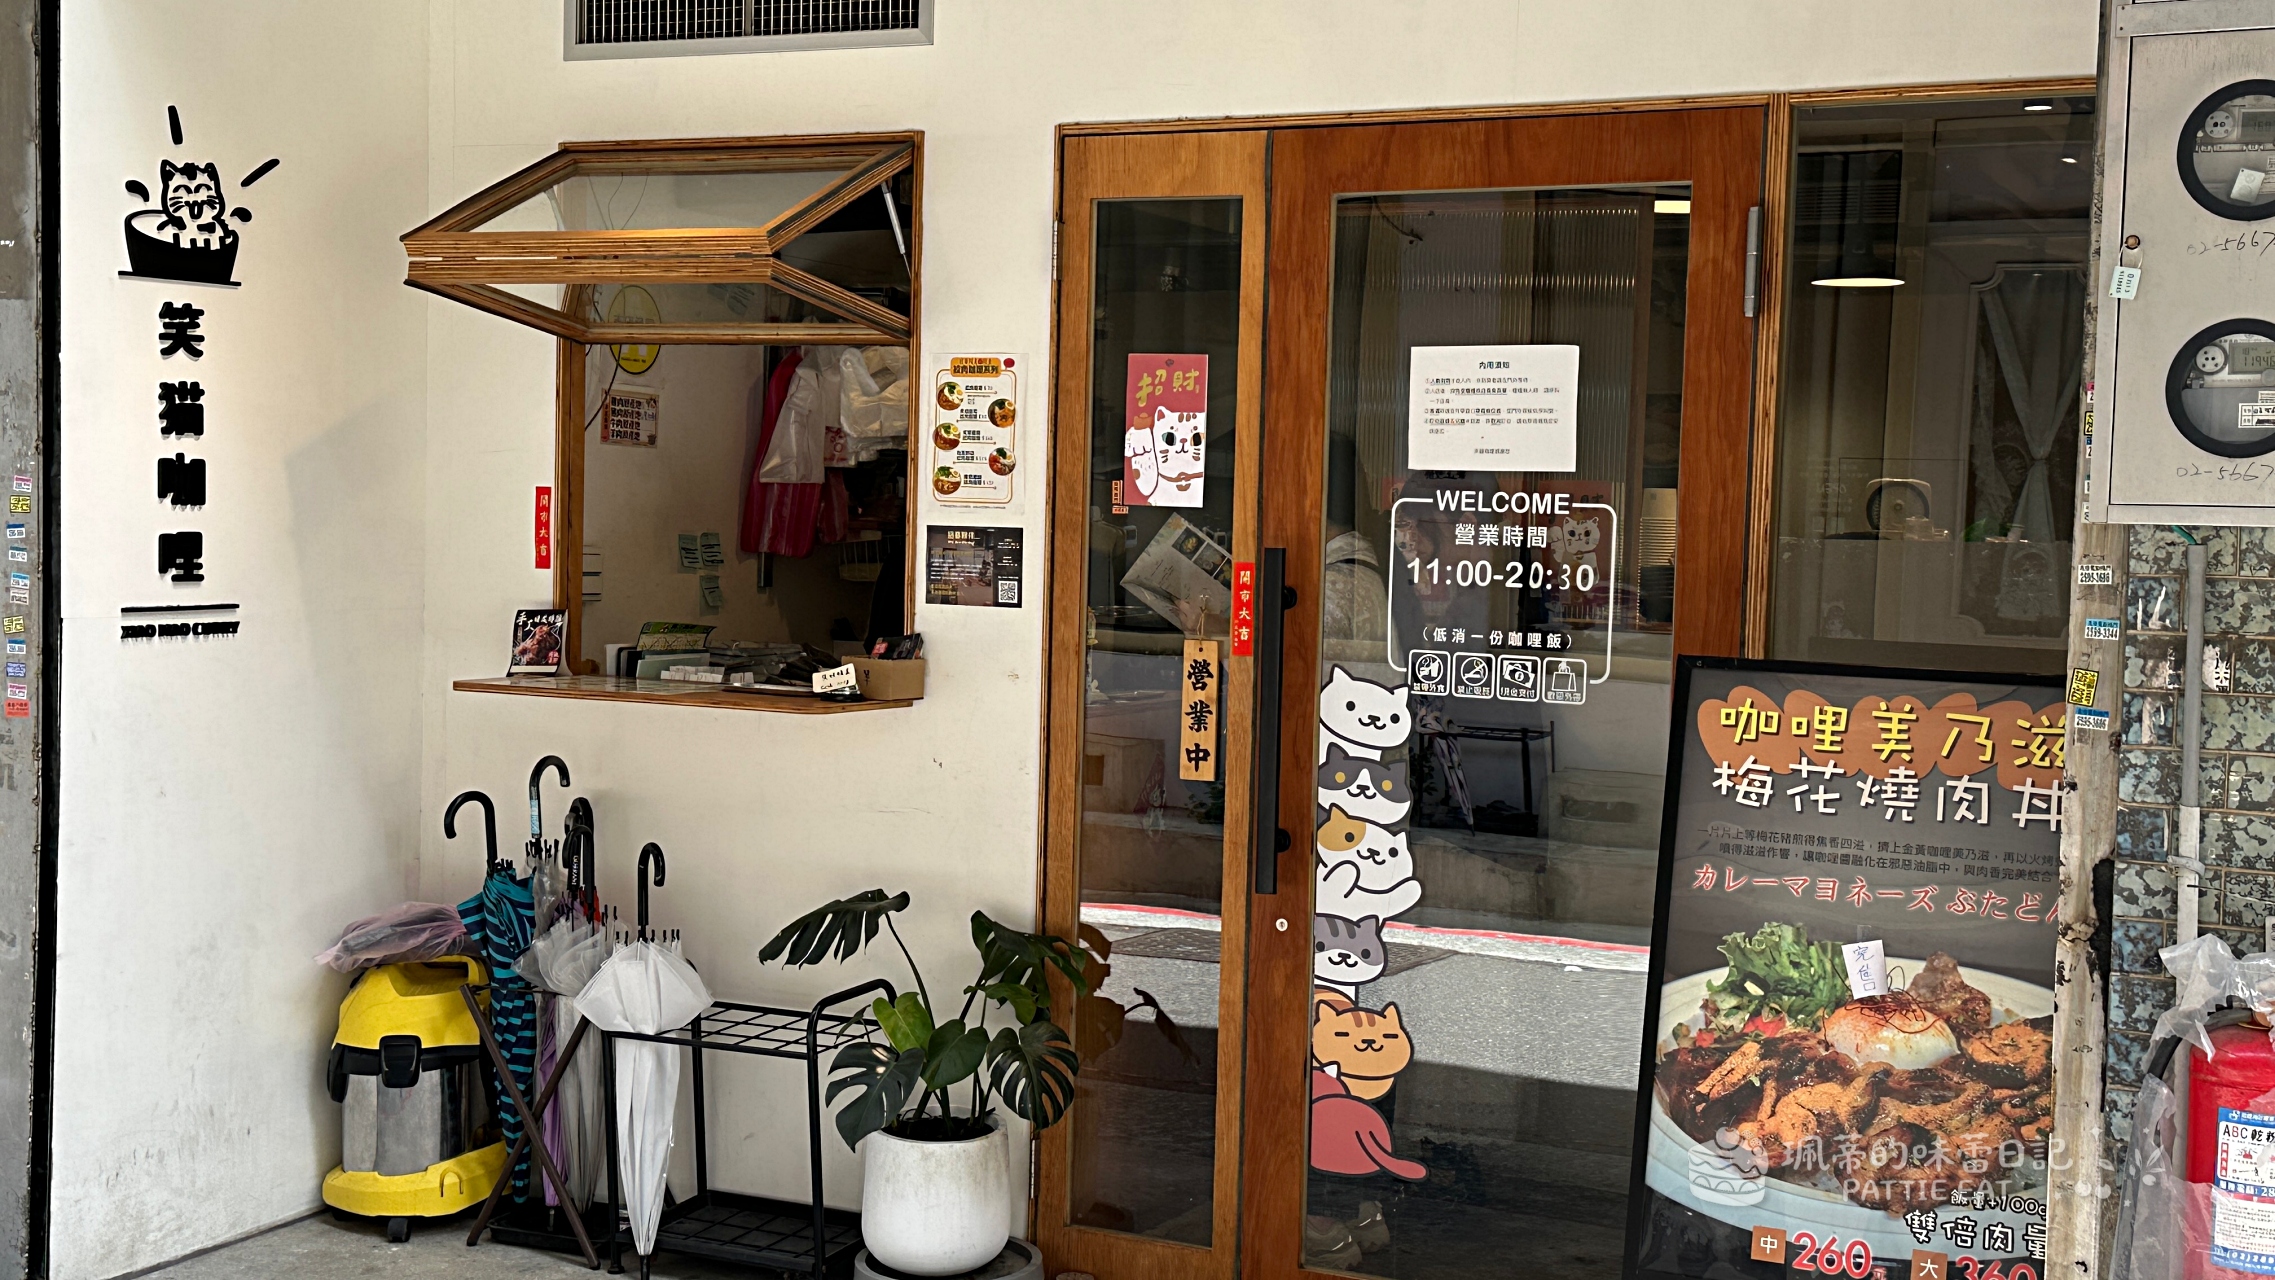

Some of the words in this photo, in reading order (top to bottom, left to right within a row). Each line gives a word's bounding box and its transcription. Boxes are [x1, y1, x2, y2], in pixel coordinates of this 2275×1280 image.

[1136, 368, 1200, 407] 招財
[1436, 489, 1570, 515] WELCOME
[1454, 523, 1548, 548] 營業時間
[1407, 557, 1595, 591] 11:00-20:30
[1239, 570, 1251, 641] 開市大吉
[1184, 658, 1214, 772] 營業中
[1719, 697, 2065, 768] 咖哩美乃滋
[1692, 864, 1940, 913] カレーマヨネーズ
[1759, 1234, 1779, 1255] 中
[1791, 1231, 1872, 1279] 260
[1904, 1208, 2047, 1260] 雙倍肉量
[1919, 1258, 1939, 1279] 大
